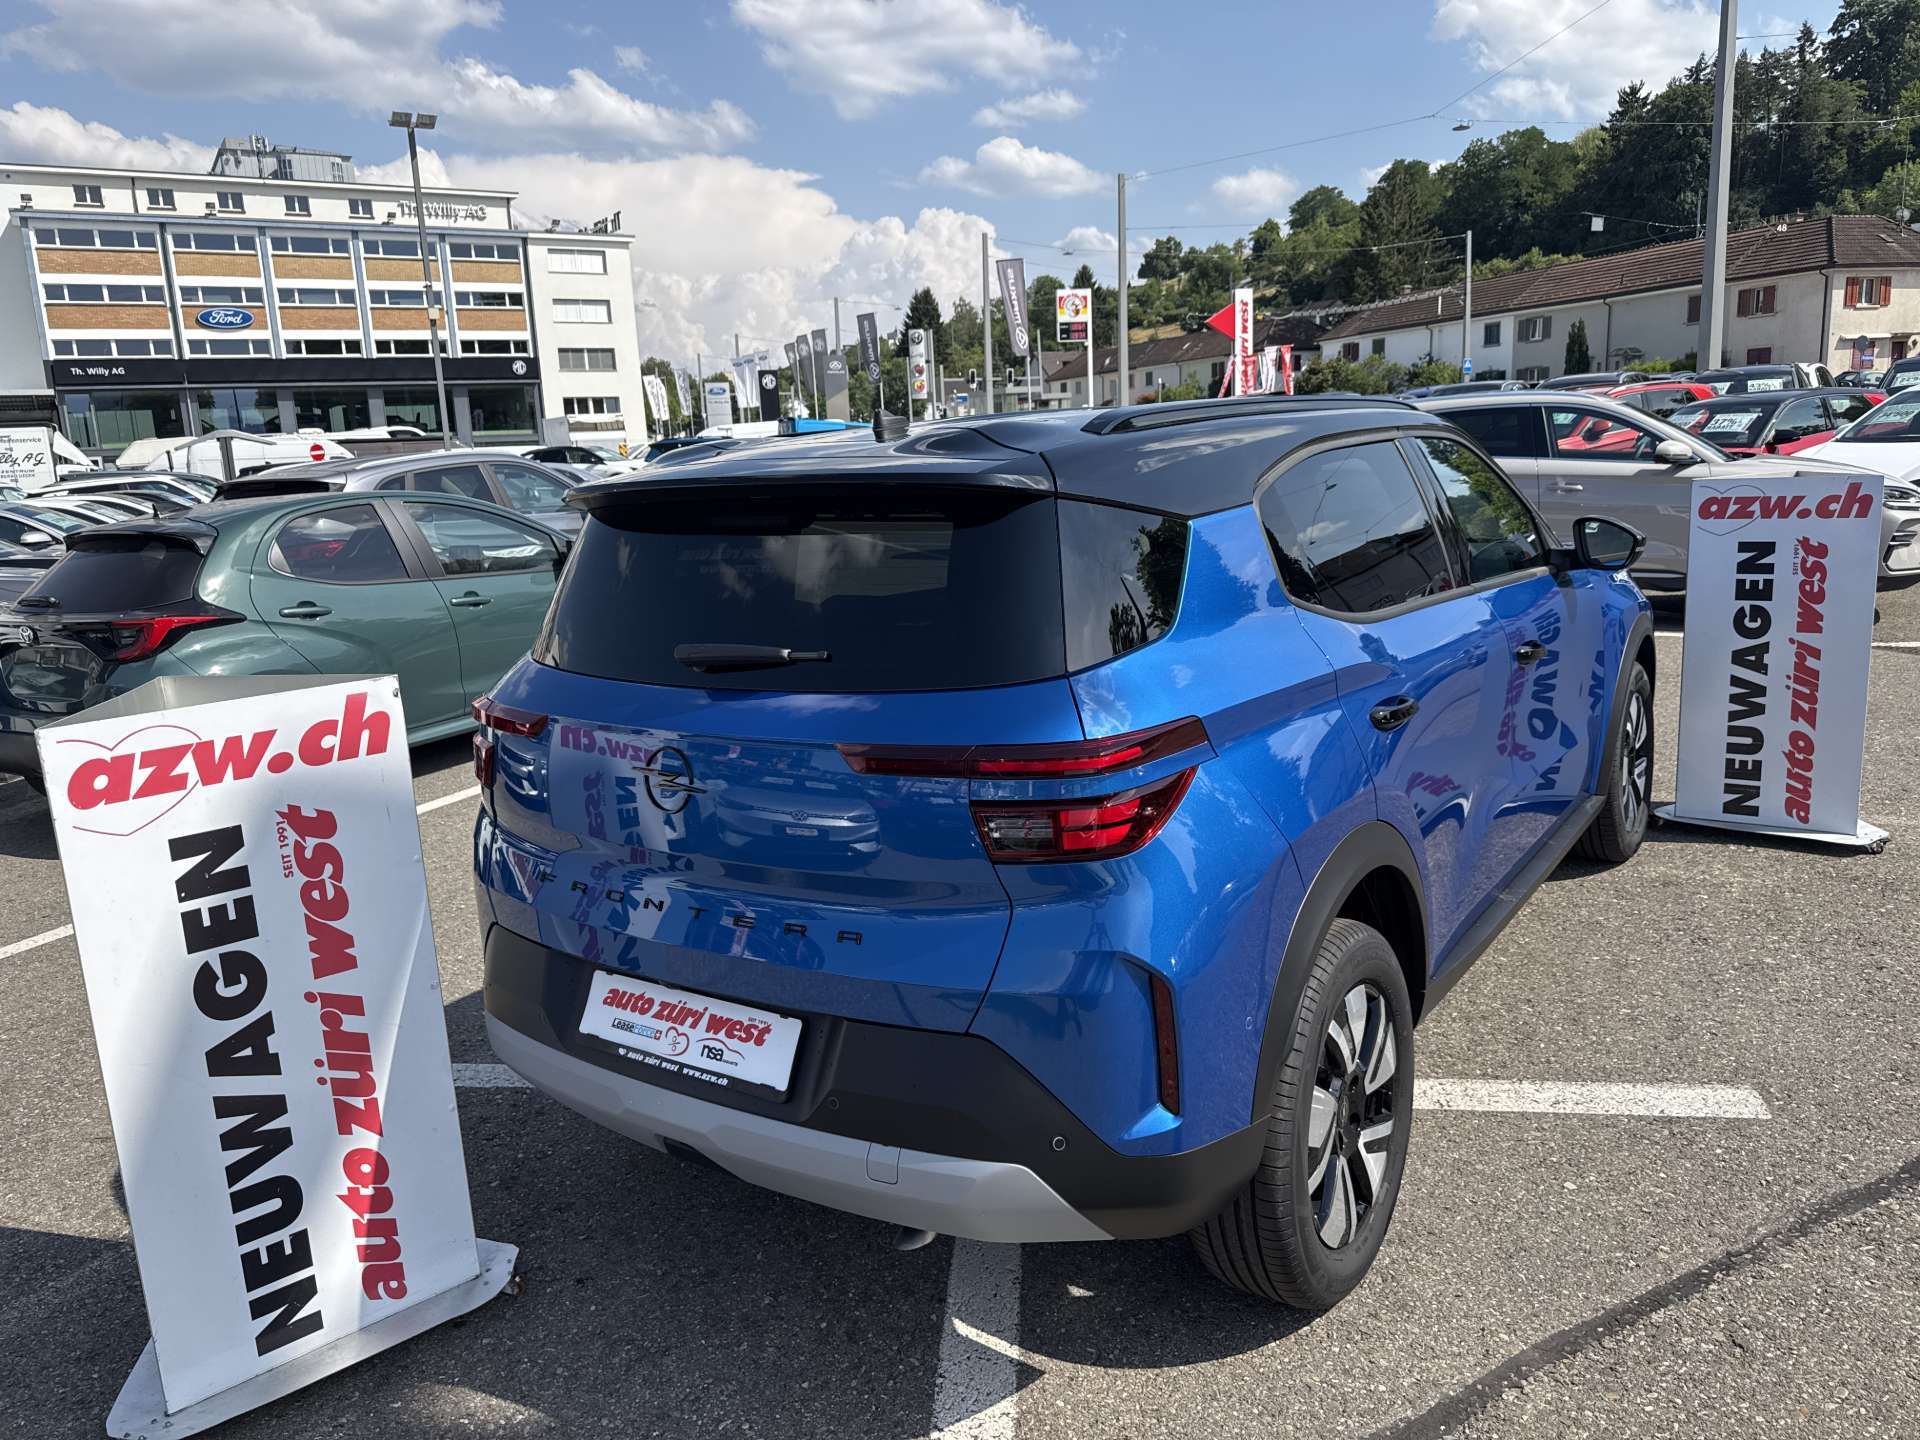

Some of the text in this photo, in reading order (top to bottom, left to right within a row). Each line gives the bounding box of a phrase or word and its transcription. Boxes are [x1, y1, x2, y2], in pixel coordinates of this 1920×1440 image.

[464, 204, 487, 221] AG
[1776, 224, 1788, 232] 48
[209, 310, 244, 324] Ford
[70, 366, 126, 377] Th. Willy AG
[1698, 482, 1875, 520] azw.ch
[1723, 541, 1776, 817] NEUWAGEN
[1780, 536, 1828, 825] auto züri west
[66, 692, 391, 810] azw.ch
[276, 820, 294, 878] SEIT 1991
[539, 869, 864, 946] FRONTERA
[603, 987, 773, 1047] auto züri west
[275, 804, 407, 1301] auto züri west
[627, 1051, 644, 1061] auto
[661, 1061, 680, 1073] west
[682, 1066, 729, 1087] www.azw.ch
[701, 1044, 724, 1062] nsa
[168, 824, 326, 1357] NEUWAGEN
